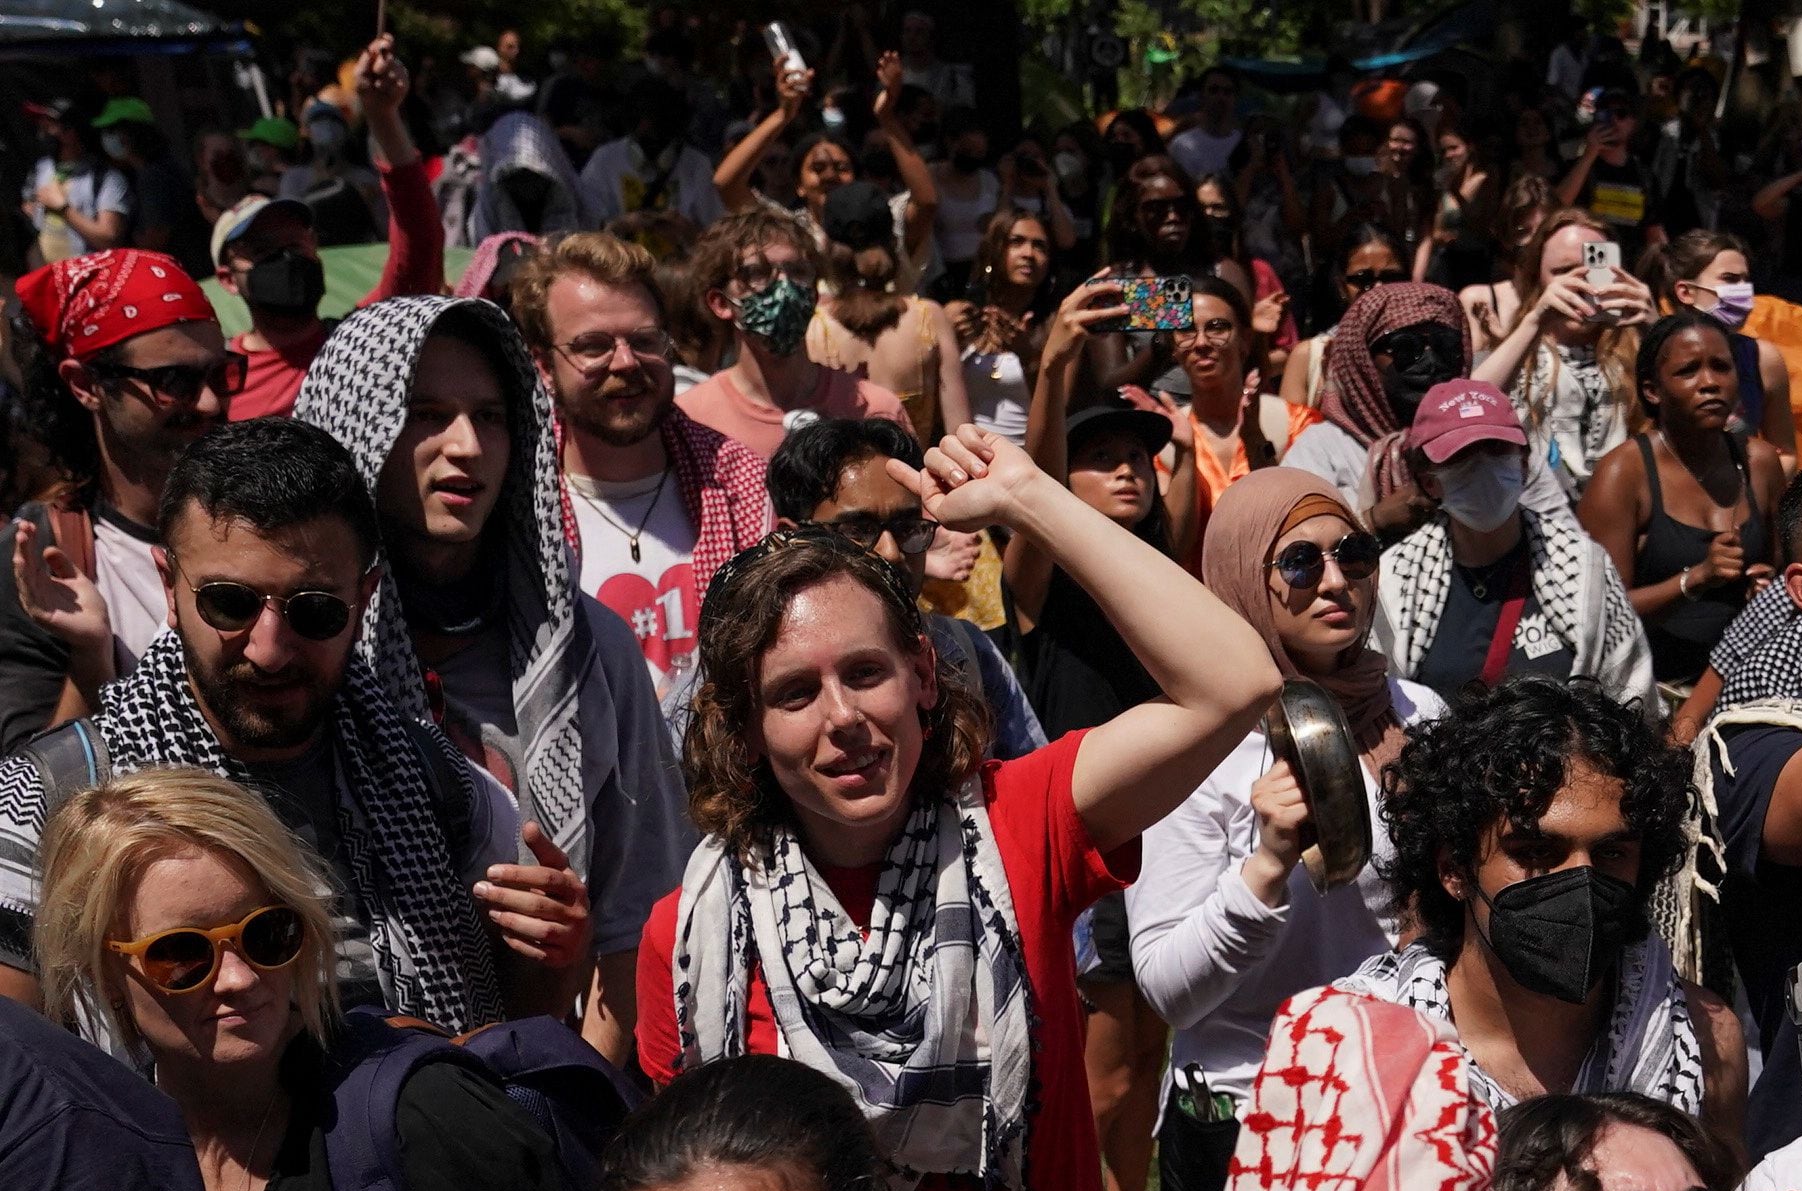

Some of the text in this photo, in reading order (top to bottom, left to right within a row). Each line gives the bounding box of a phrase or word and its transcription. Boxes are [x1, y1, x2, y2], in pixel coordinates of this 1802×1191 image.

[1438, 391, 1498, 412] New York
[631, 586, 694, 641] #1
